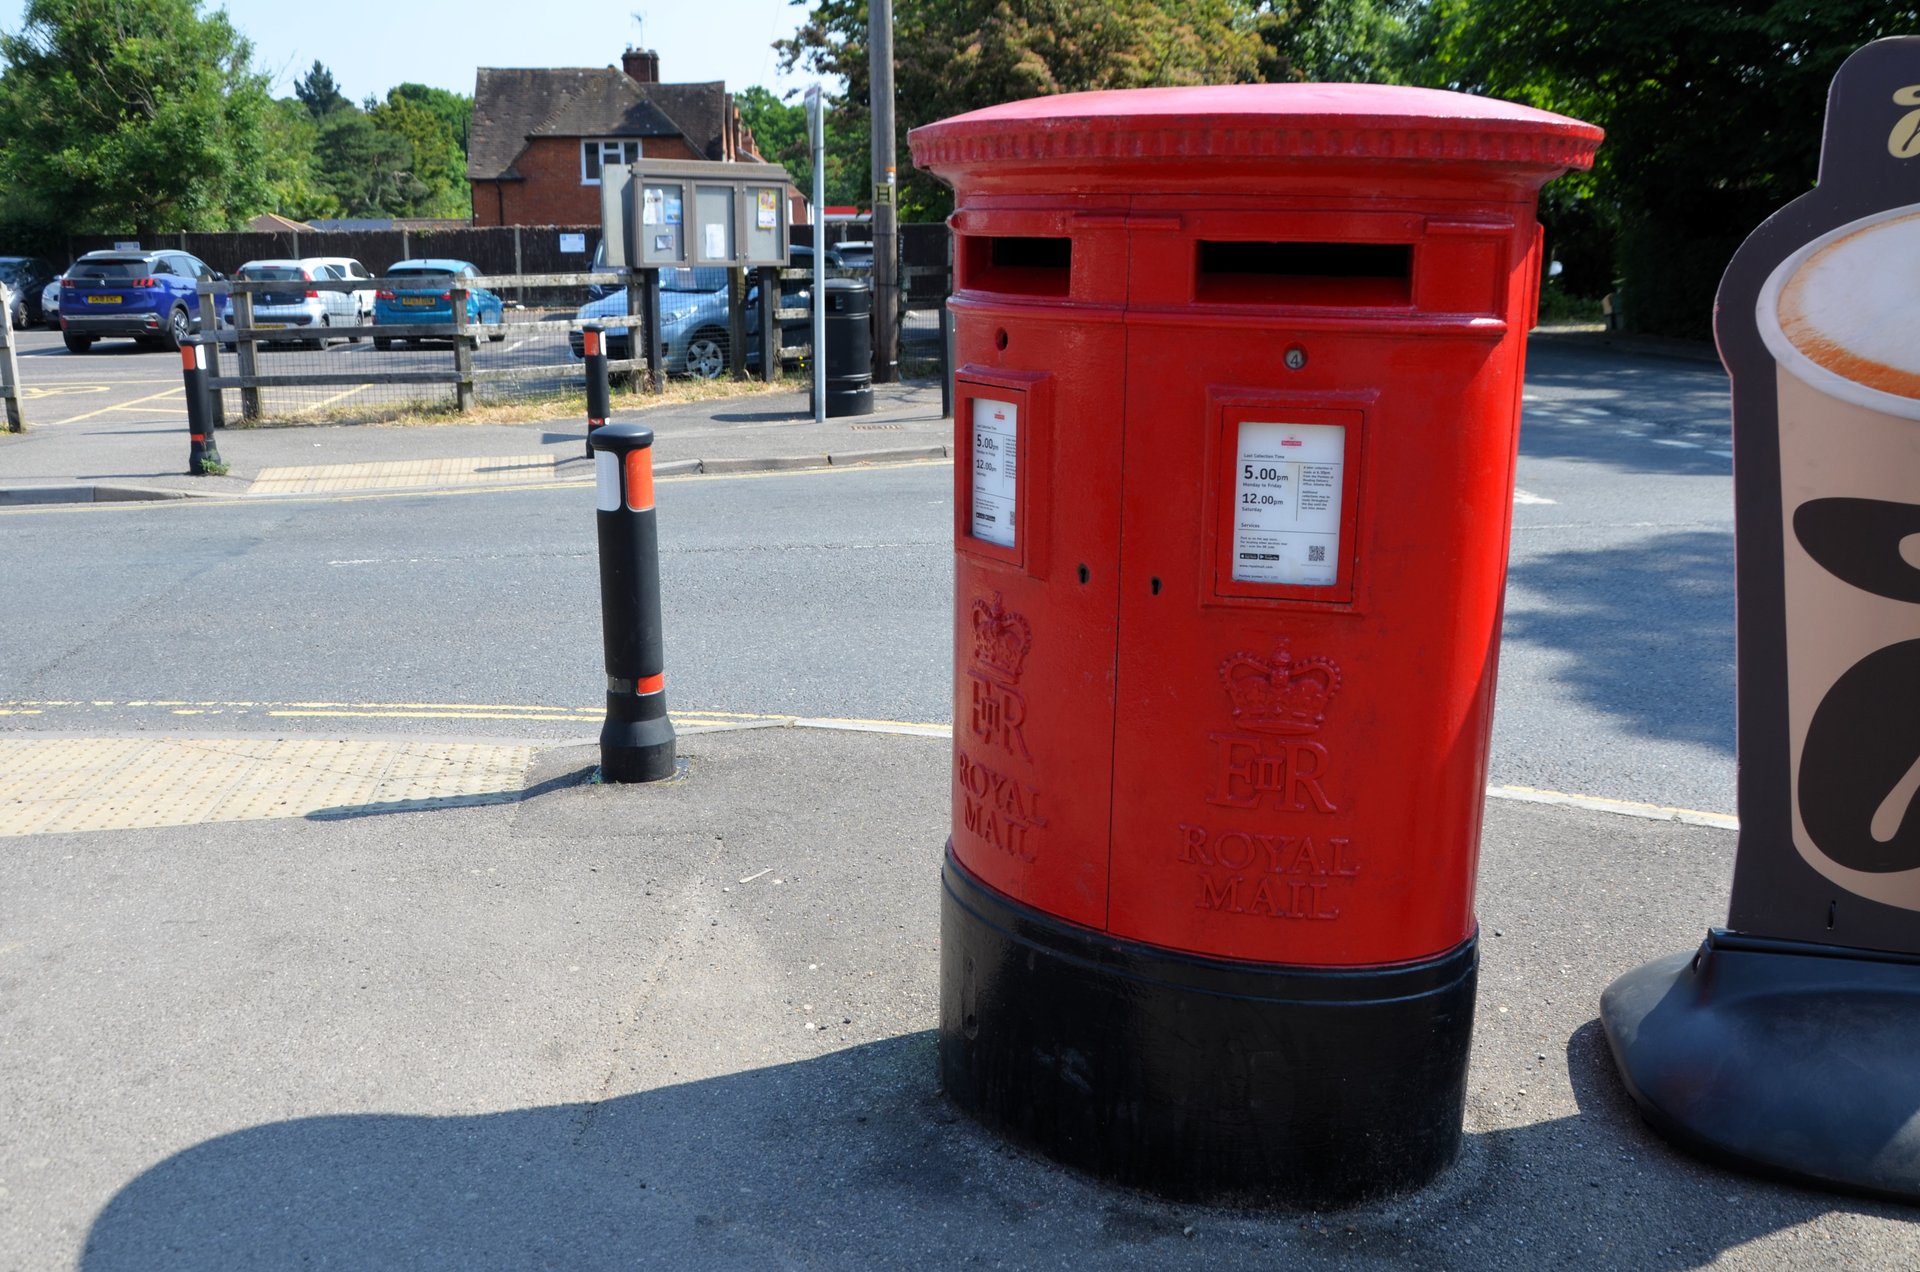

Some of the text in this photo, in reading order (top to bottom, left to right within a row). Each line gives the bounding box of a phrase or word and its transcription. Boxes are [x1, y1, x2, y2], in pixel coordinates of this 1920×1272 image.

[1290, 353, 1300, 367] 4
[1244, 465, 1289, 482] 5.00pm
[1242, 493, 1284, 506] 12.00pm
[960, 752, 1047, 829] ROYAL
[964, 797, 1036, 863] MAIL
[1178, 823, 1361, 877] ROYAL
[1196, 872, 1340, 920] MAIL
